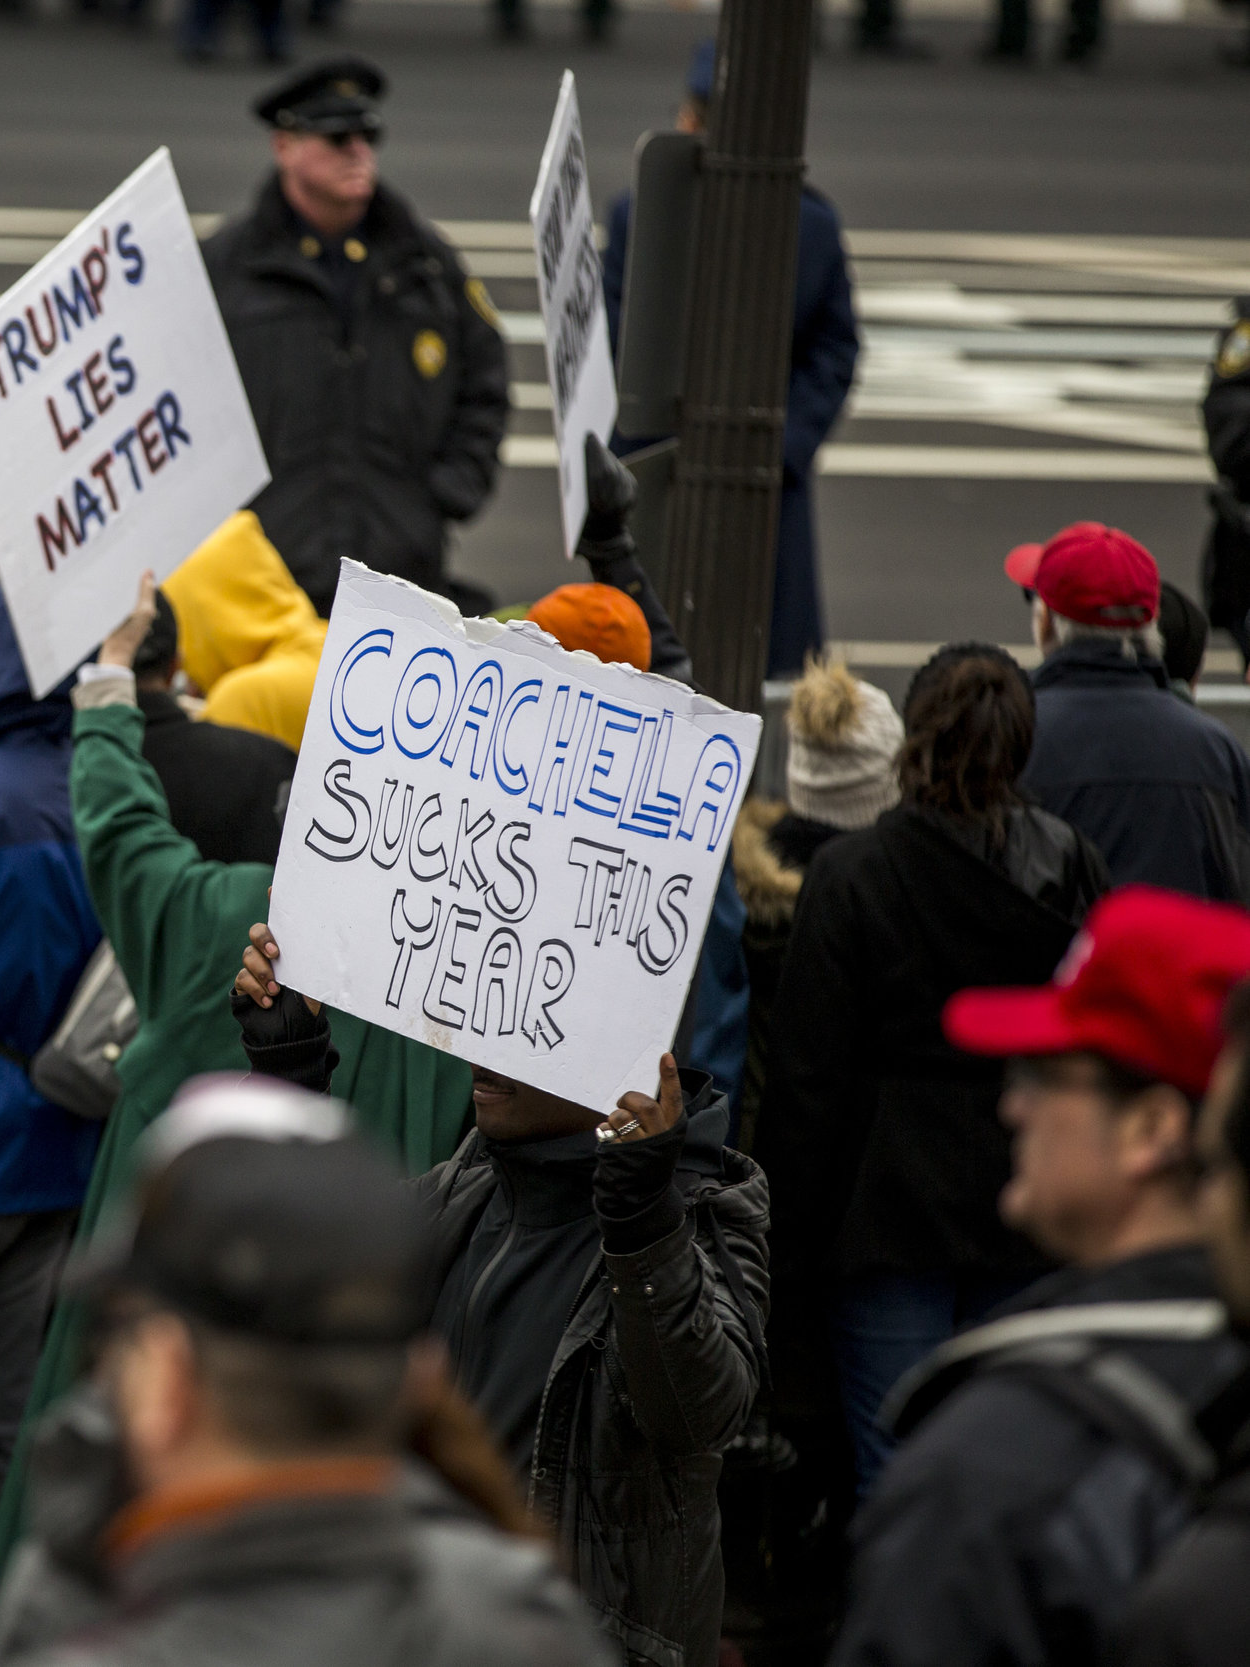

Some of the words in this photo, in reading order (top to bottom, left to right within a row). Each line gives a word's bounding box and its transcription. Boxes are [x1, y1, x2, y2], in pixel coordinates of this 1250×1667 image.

[36, 390, 191, 572] MATTER
[46, 334, 138, 452] LIES
[329, 628, 742, 852] COACHELLA
[304, 758, 538, 924] SUCKS
[568, 836, 693, 976] THIS
[385, 888, 576, 1050] YEAR
